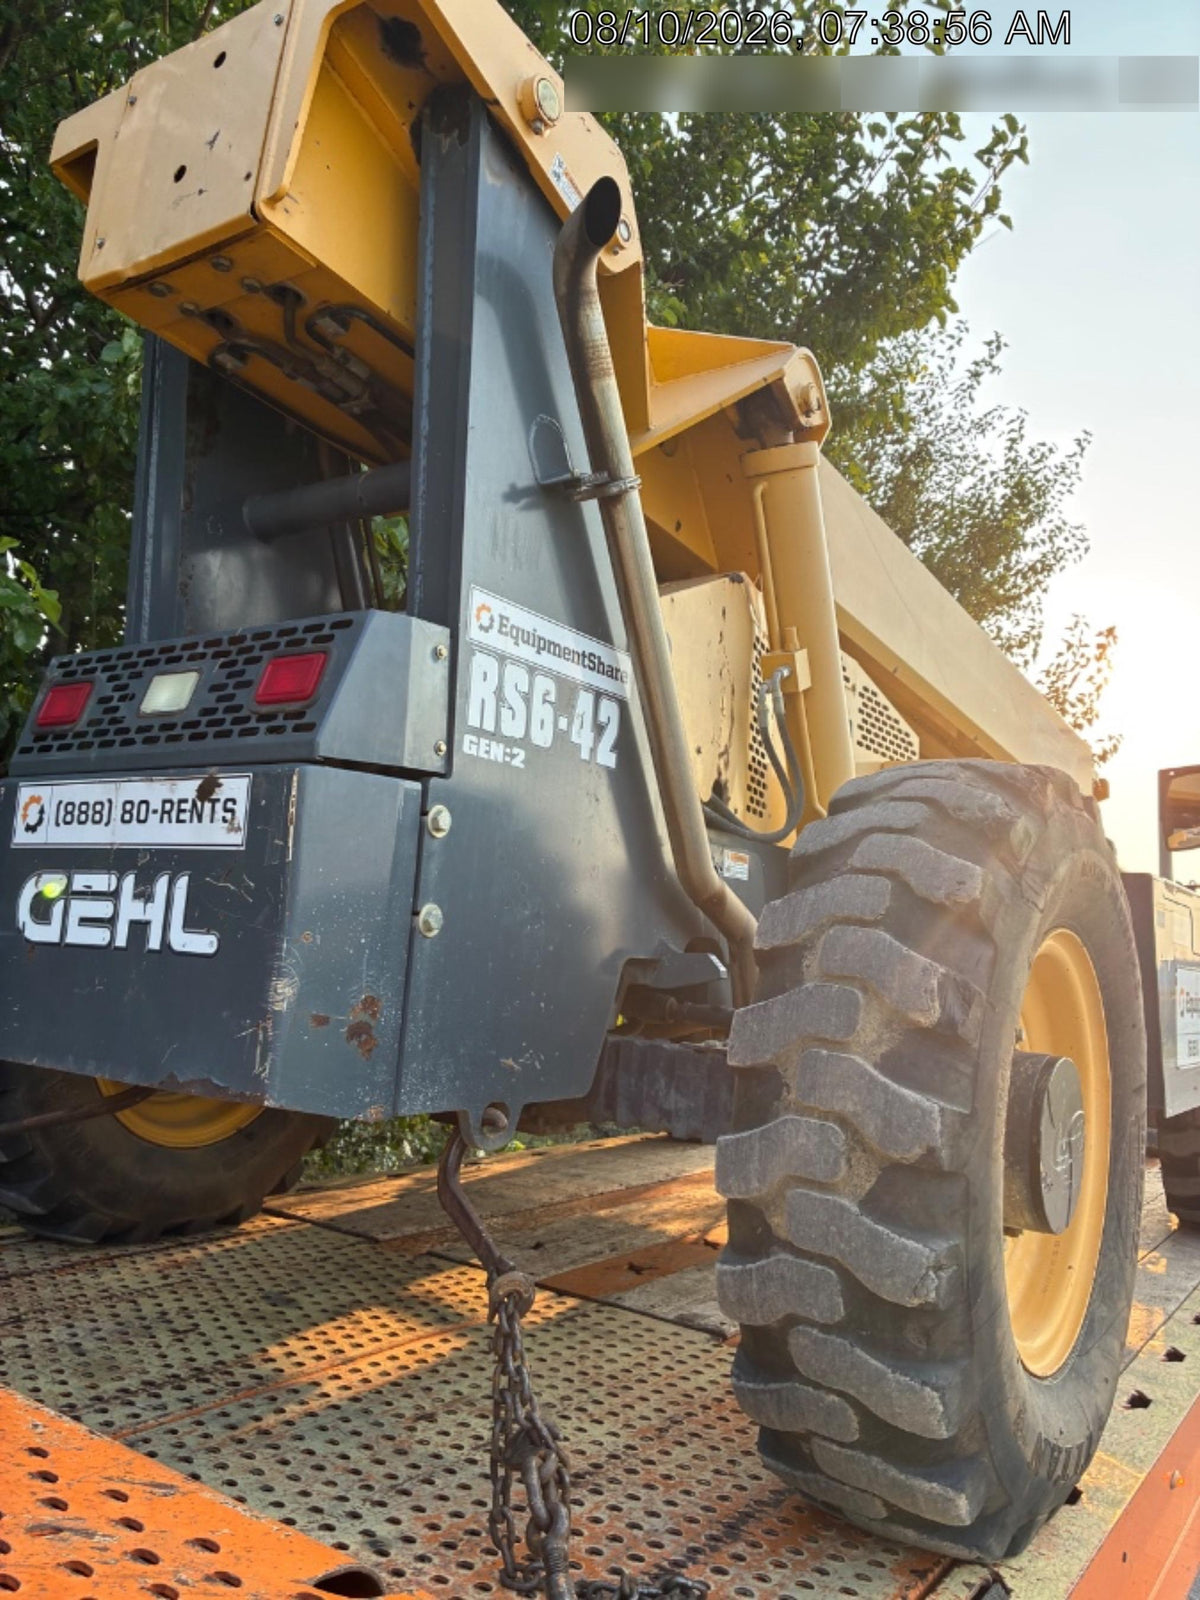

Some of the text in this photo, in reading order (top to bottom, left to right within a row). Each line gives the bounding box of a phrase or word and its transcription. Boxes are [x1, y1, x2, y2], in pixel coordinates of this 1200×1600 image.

[497, 613, 629, 684] EquipmentShare
[467, 650, 620, 769] RS6-42
[462, 733, 526, 769] GEN:2
[54, 797, 237, 828] (888) 80-RENTS
[17, 870, 220, 957] GEHL
